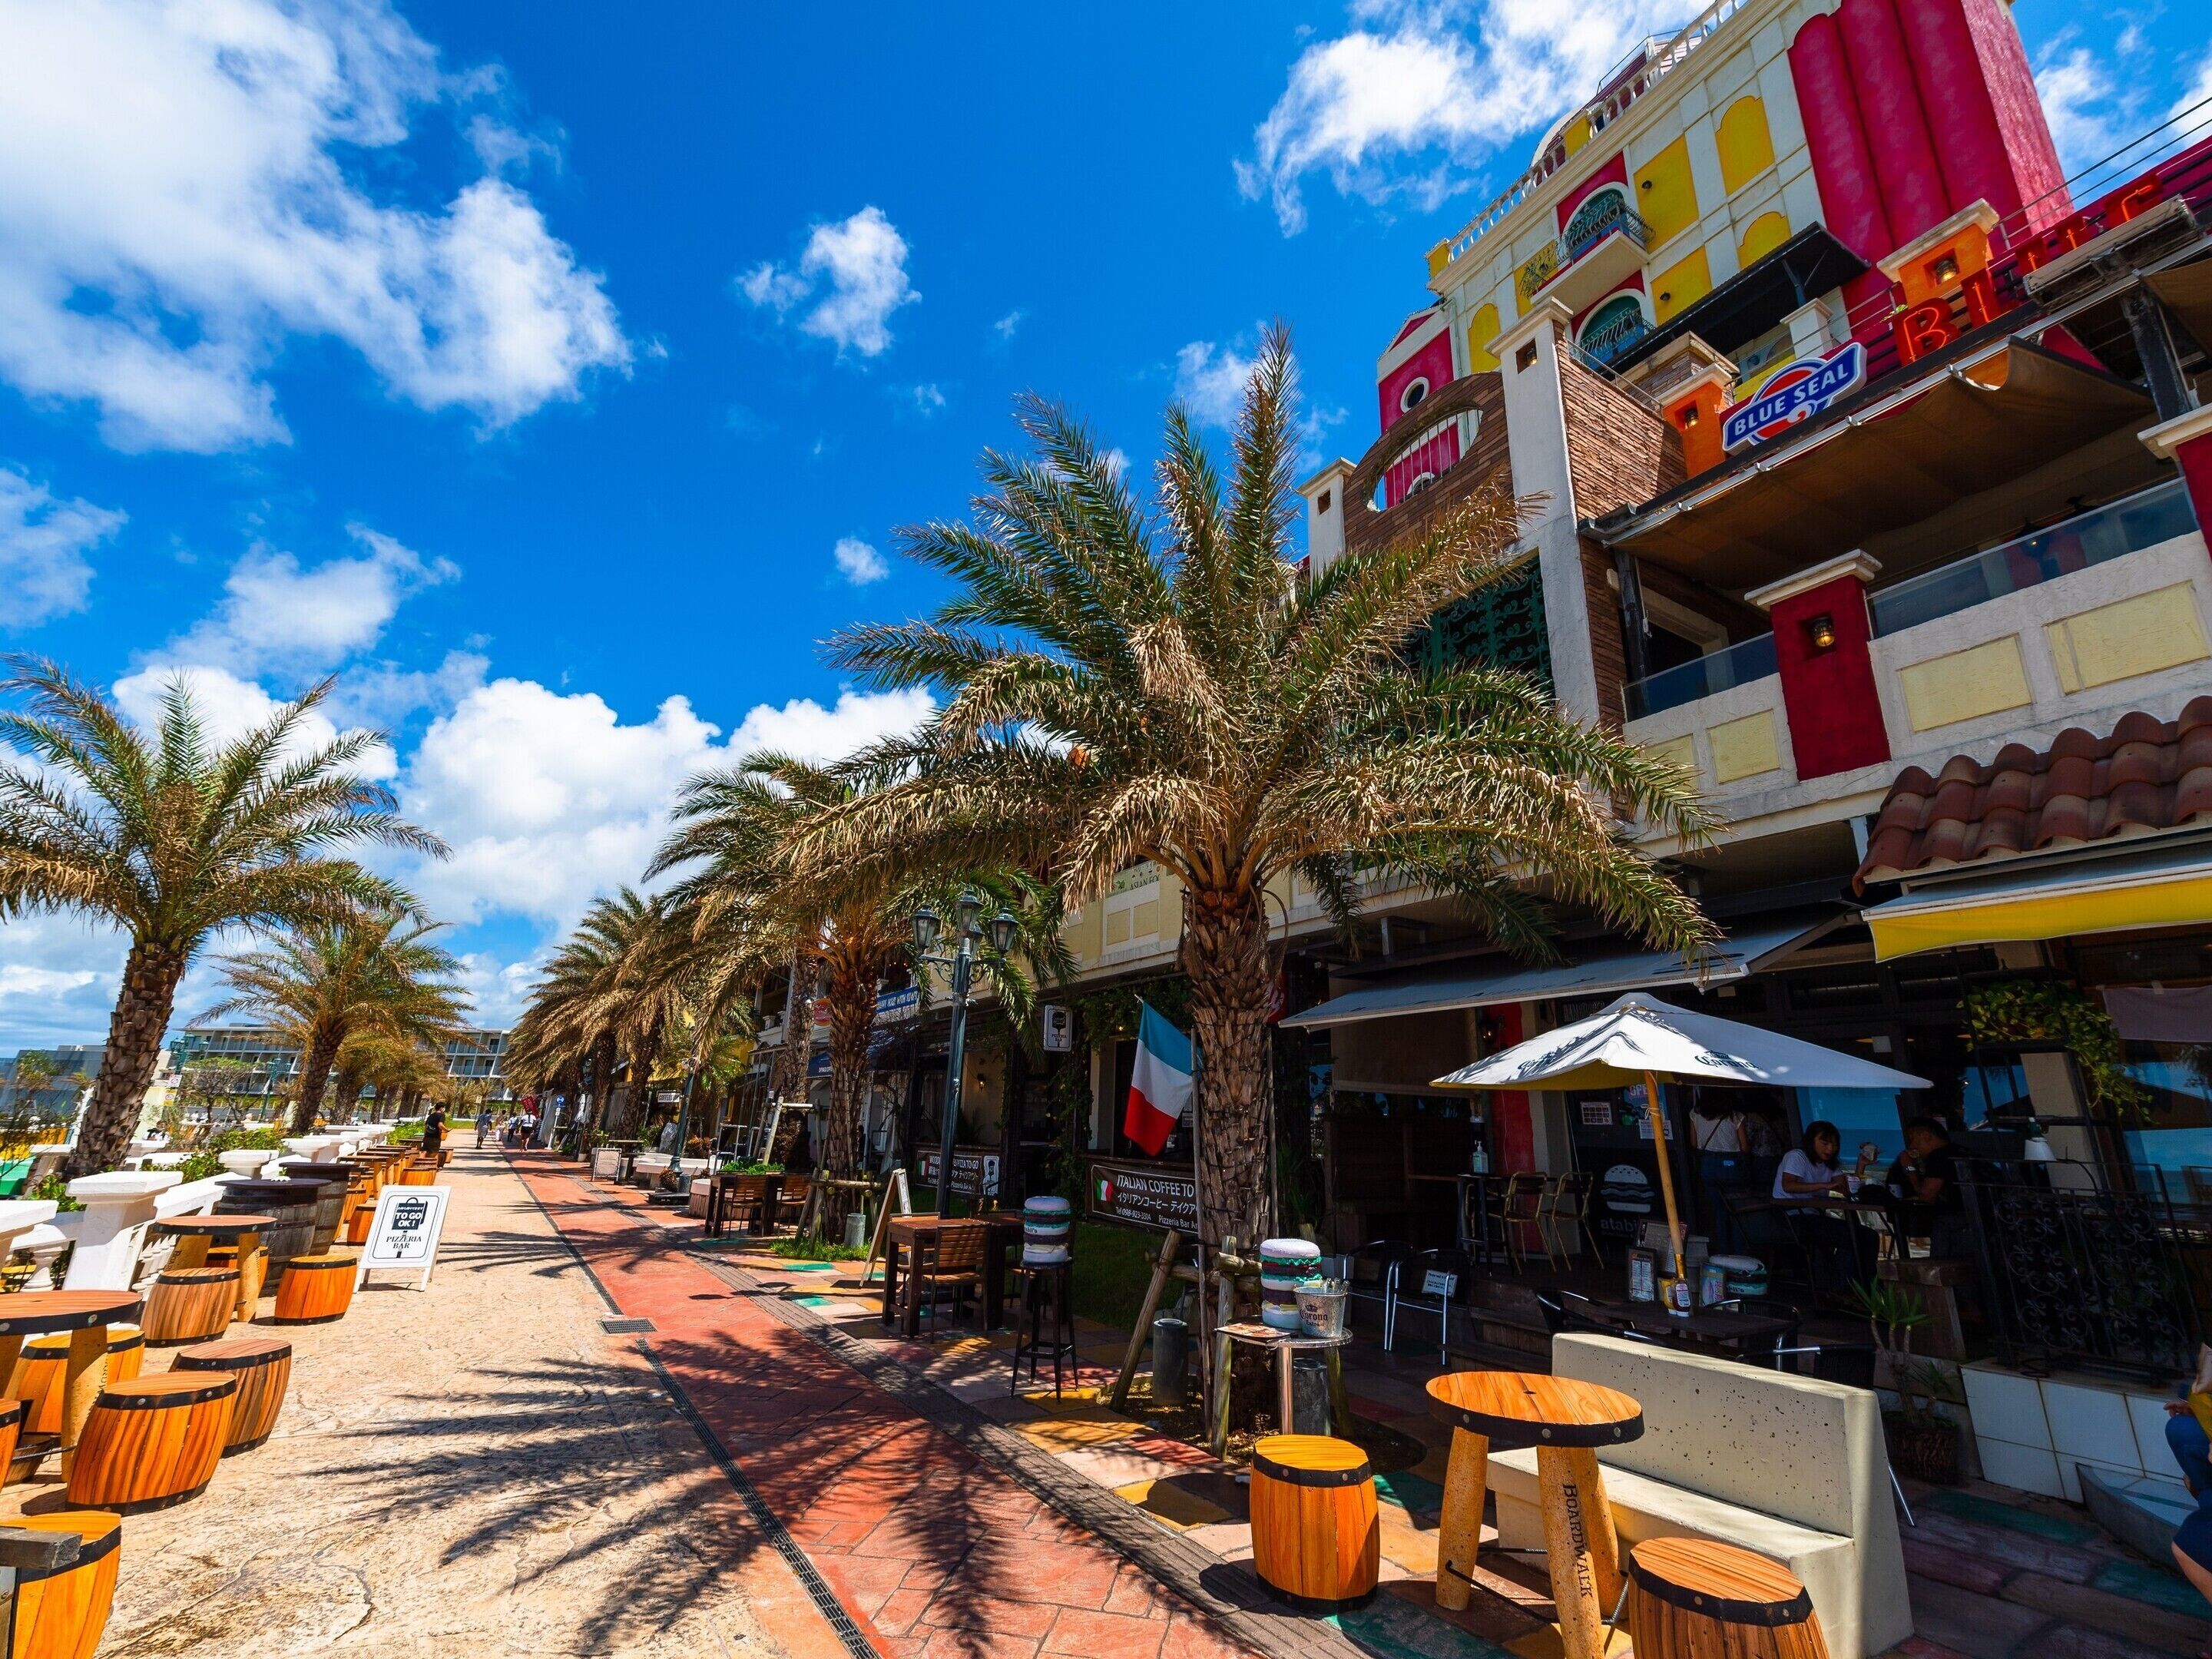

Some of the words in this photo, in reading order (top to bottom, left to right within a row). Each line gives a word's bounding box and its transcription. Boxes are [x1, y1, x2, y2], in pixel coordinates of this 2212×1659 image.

[1734, 395, 1786, 436] BLUE
[1793, 363, 1849, 404] SEAL
[1694, 1055, 1763, 1070] Corona
[1629, 1084, 1647, 1097] OPE
[1117, 1174, 1147, 1191] ITALIAN
[1148, 1180, 1181, 1196] COFFEE
[1181, 1184, 1194, 1197] TO
[1118, 1192, 1168, 1209] イタリアンコーヒー
[1171, 1200, 1197, 1215] テイクア
[1158, 1215, 1179, 1227] Pizzeria
[1180, 1219, 1190, 1229] Bar
[1300, 1309, 1328, 1322] Corona
[1306, 1319, 1320, 1327] Extra
[1562, 1483, 1593, 1598] BOARDWALK
